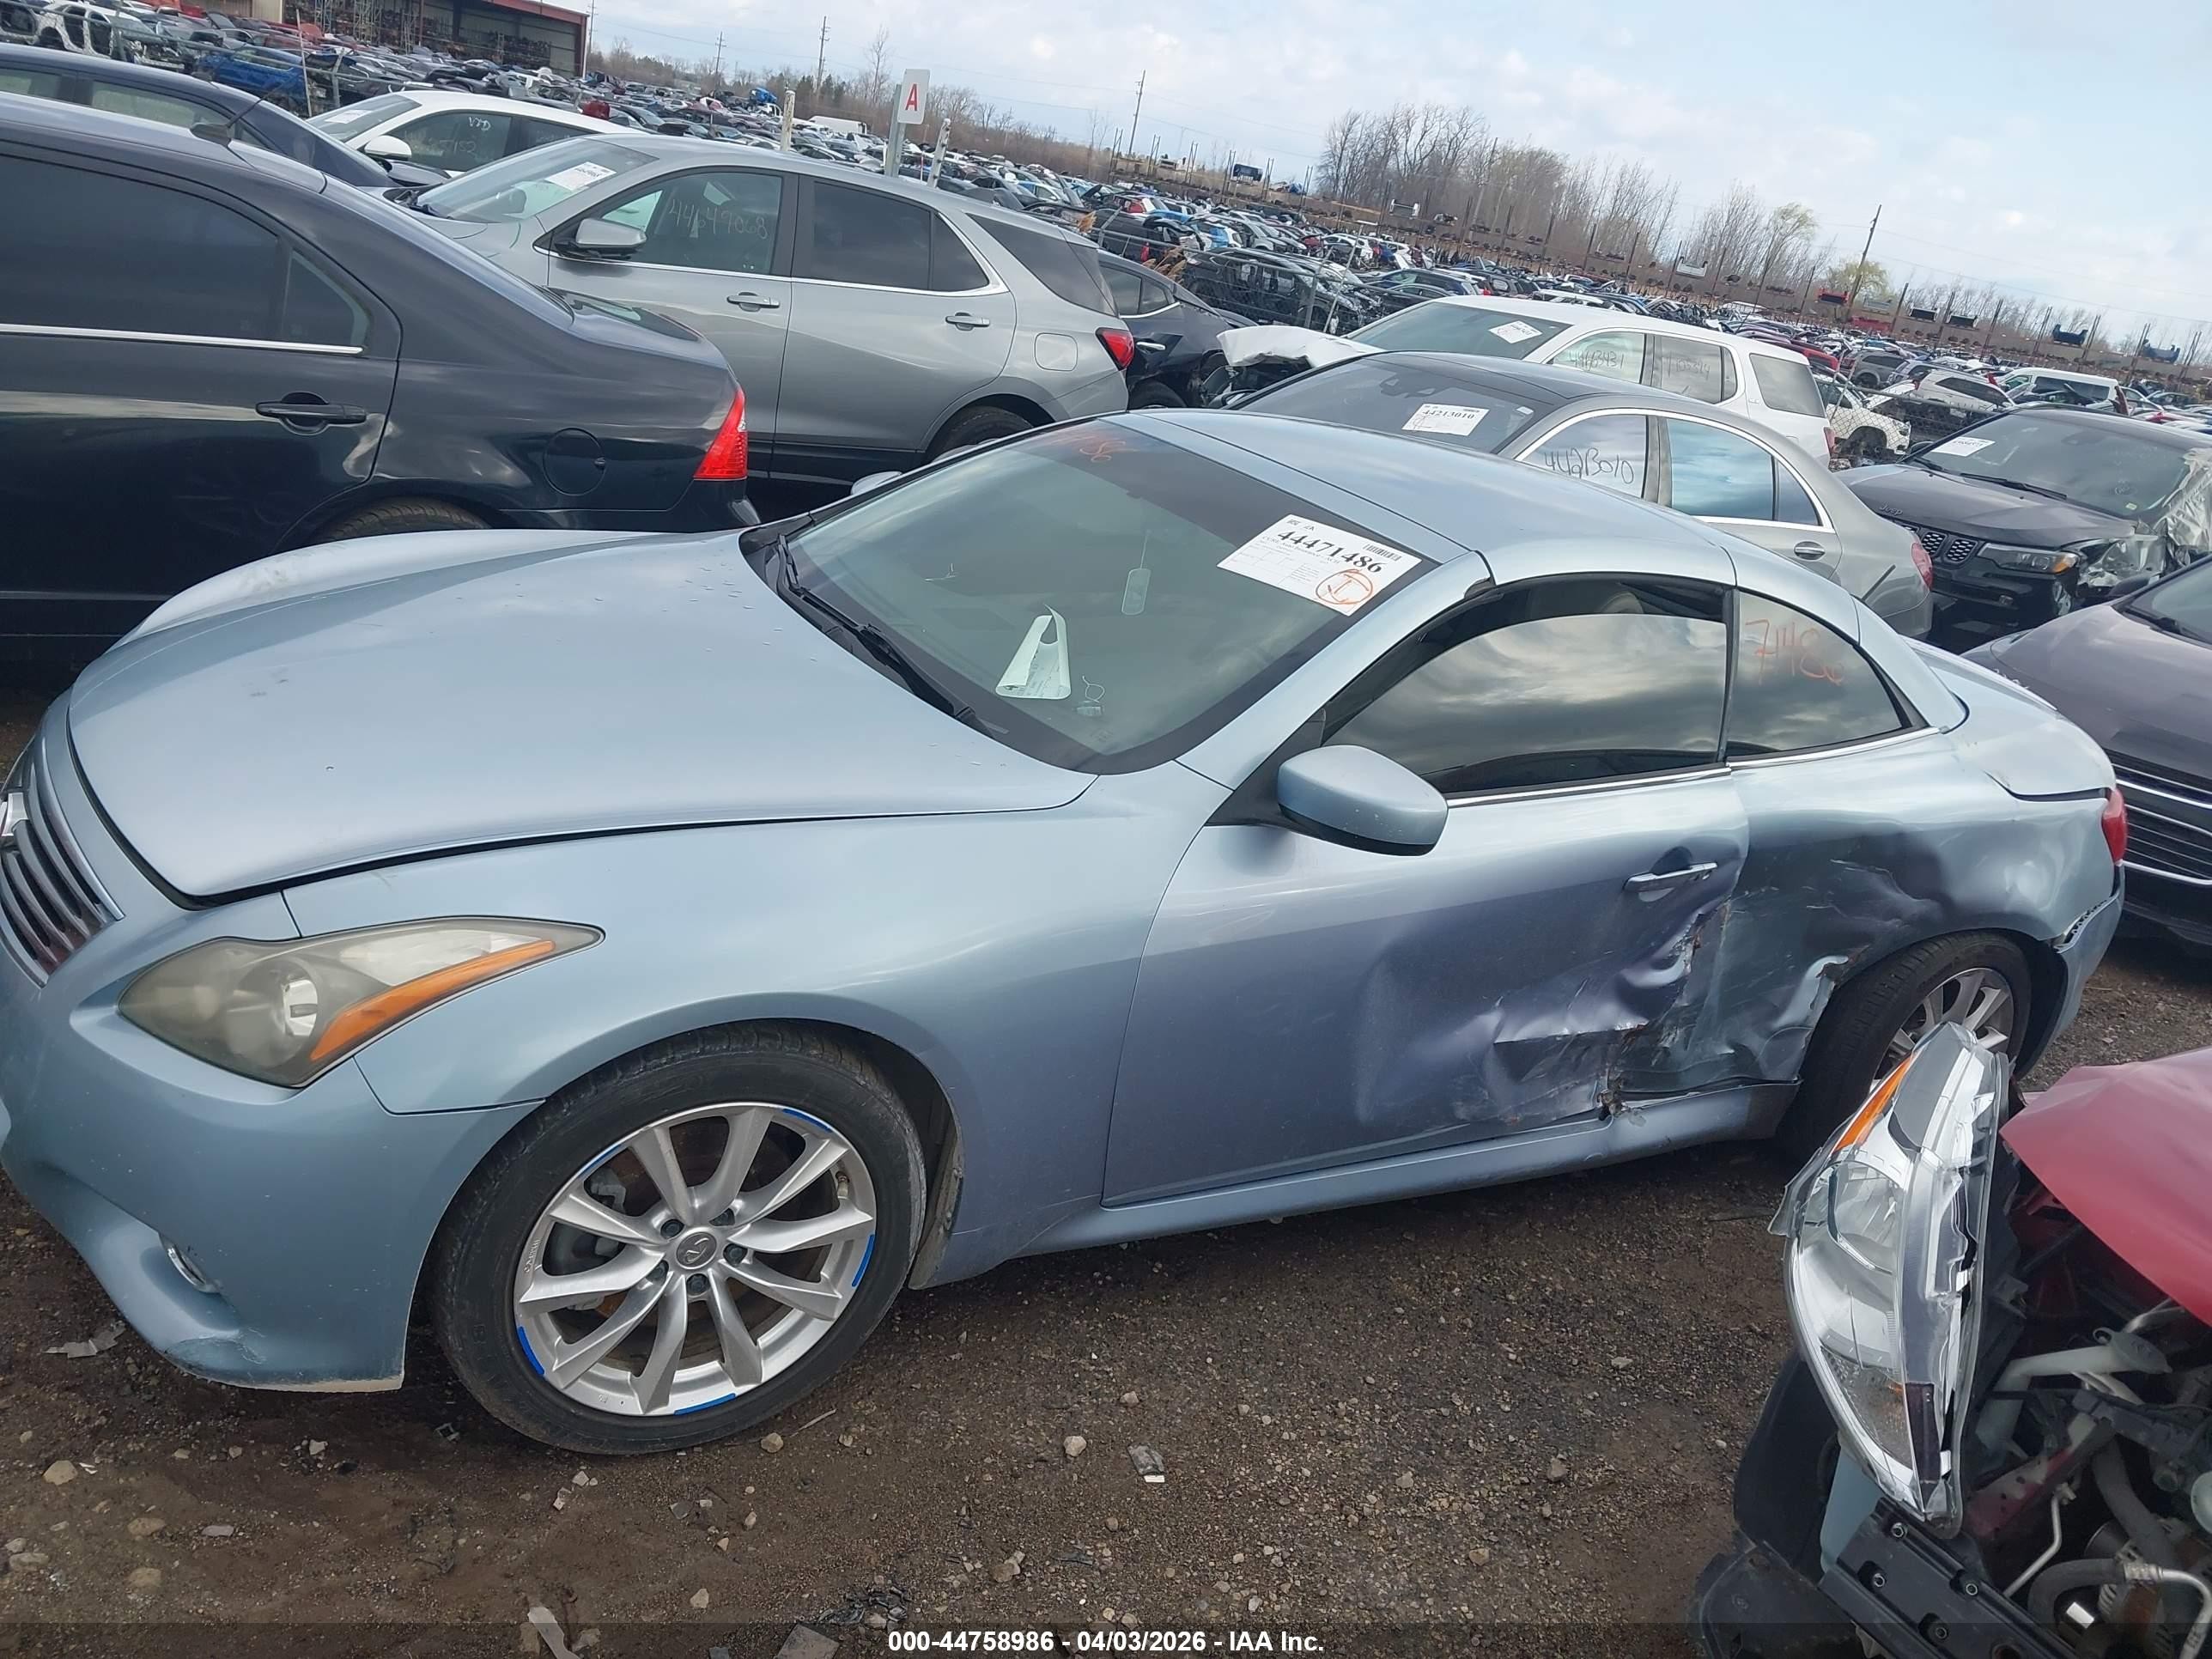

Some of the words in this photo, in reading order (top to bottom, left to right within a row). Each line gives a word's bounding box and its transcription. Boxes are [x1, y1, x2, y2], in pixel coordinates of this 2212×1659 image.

[905, 83, 919, 112] A
[1422, 410, 1475, 419] 44213010
[1879, 501, 1904, 516] Jeep
[1278, 531, 1388, 573] 44471486
